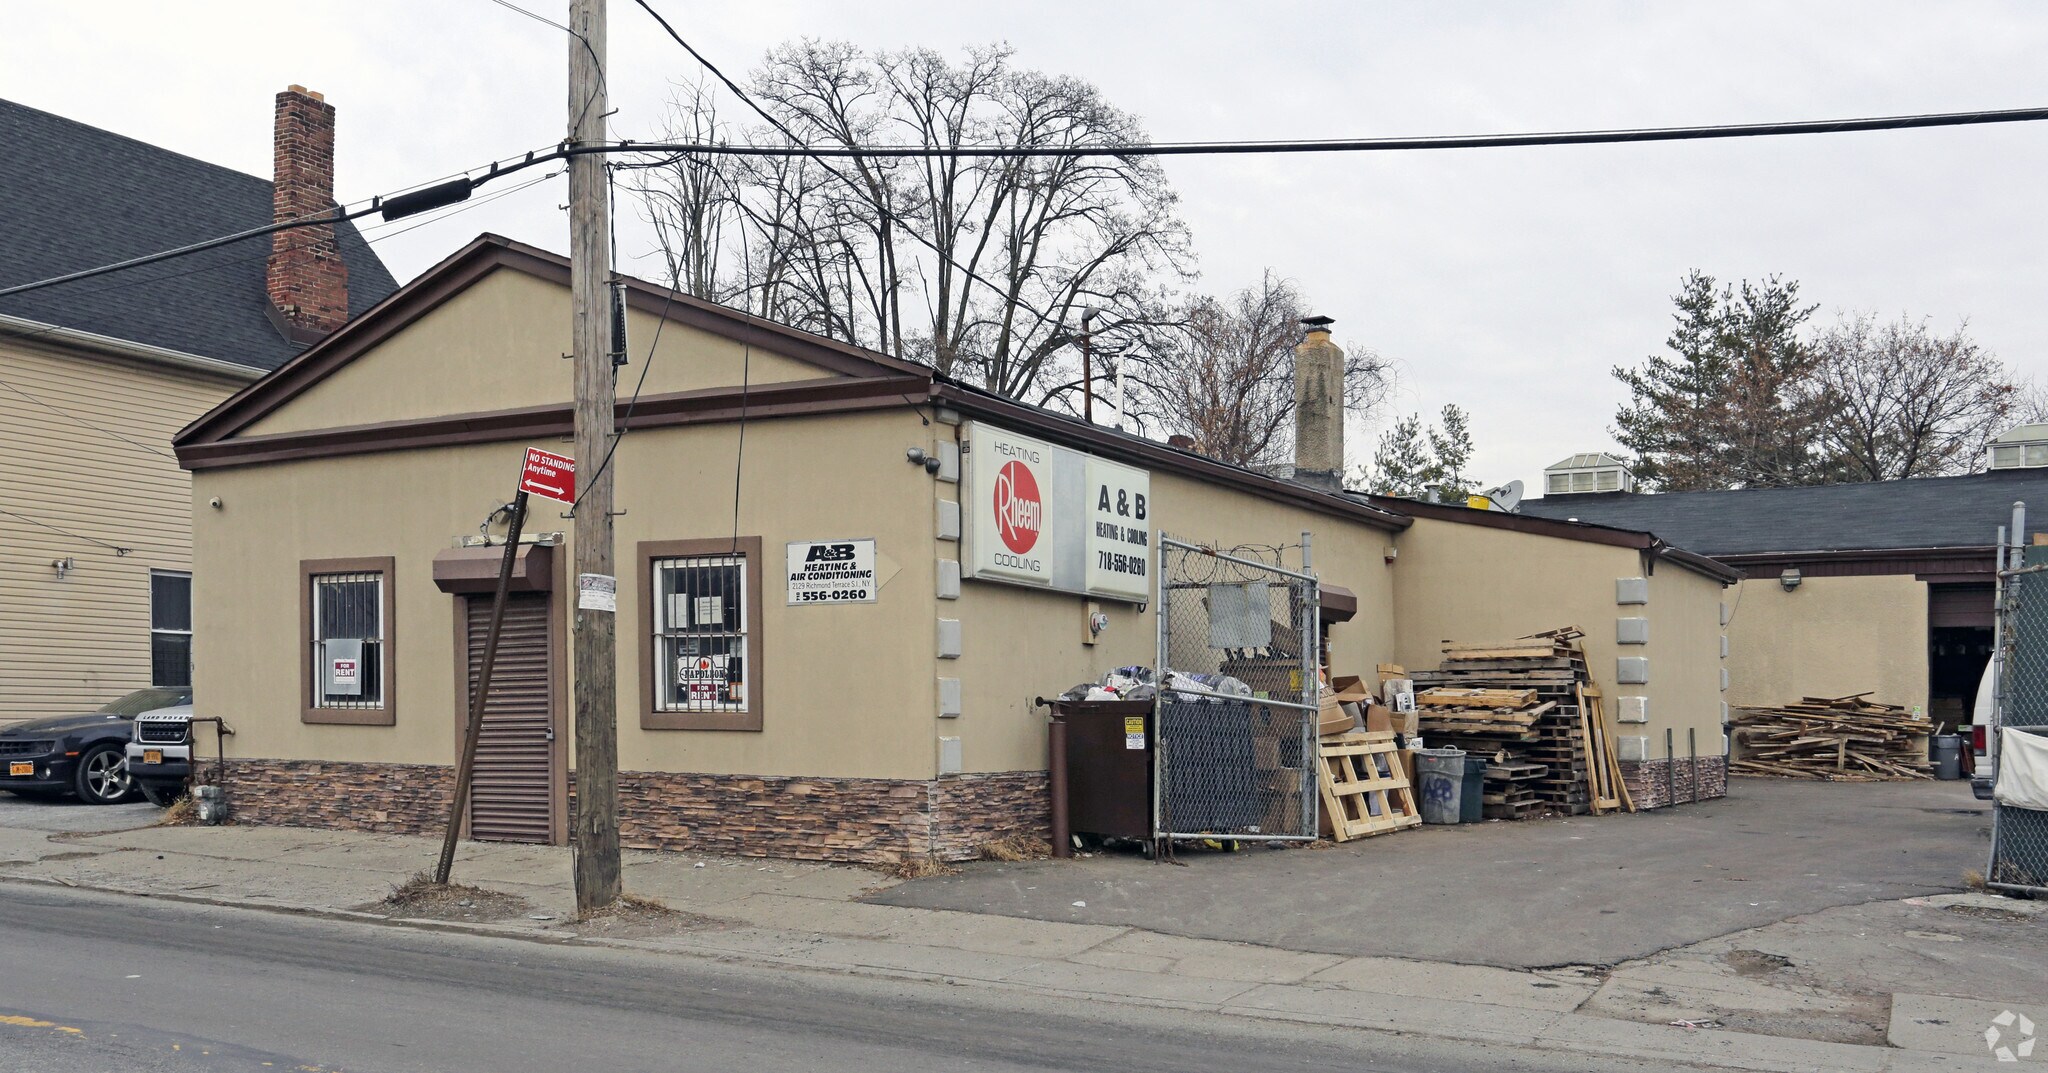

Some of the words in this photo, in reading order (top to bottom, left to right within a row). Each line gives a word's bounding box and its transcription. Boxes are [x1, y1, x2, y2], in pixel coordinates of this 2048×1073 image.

[994, 441, 1040, 464] HEATING
[528, 463, 556, 477] Anytime
[530, 453, 540, 462] NO
[541, 456, 575, 472] STANDING
[998, 461, 1040, 541] Rheem
[1098, 485, 1111, 513] A
[1117, 489, 1130, 517] &
[1135, 493, 1146, 520] B
[1096, 521, 1118, 541] HEATING
[1120, 526, 1125, 542] &
[1127, 527, 1148, 546] COOLING
[805, 544, 856, 562] A&B
[994, 553, 1041, 572] COOLING
[804, 563, 848, 572] HEATING
[850, 562, 857, 570] &
[1098, 550, 1146, 576] 718-556-0260
[790, 573, 806, 581] AIR
[808, 570, 872, 580] CONDITIONING
[792, 582, 806, 590] 2129
[806, 581, 831, 589] Richmond
[802, 589, 867, 601] 556-0260
